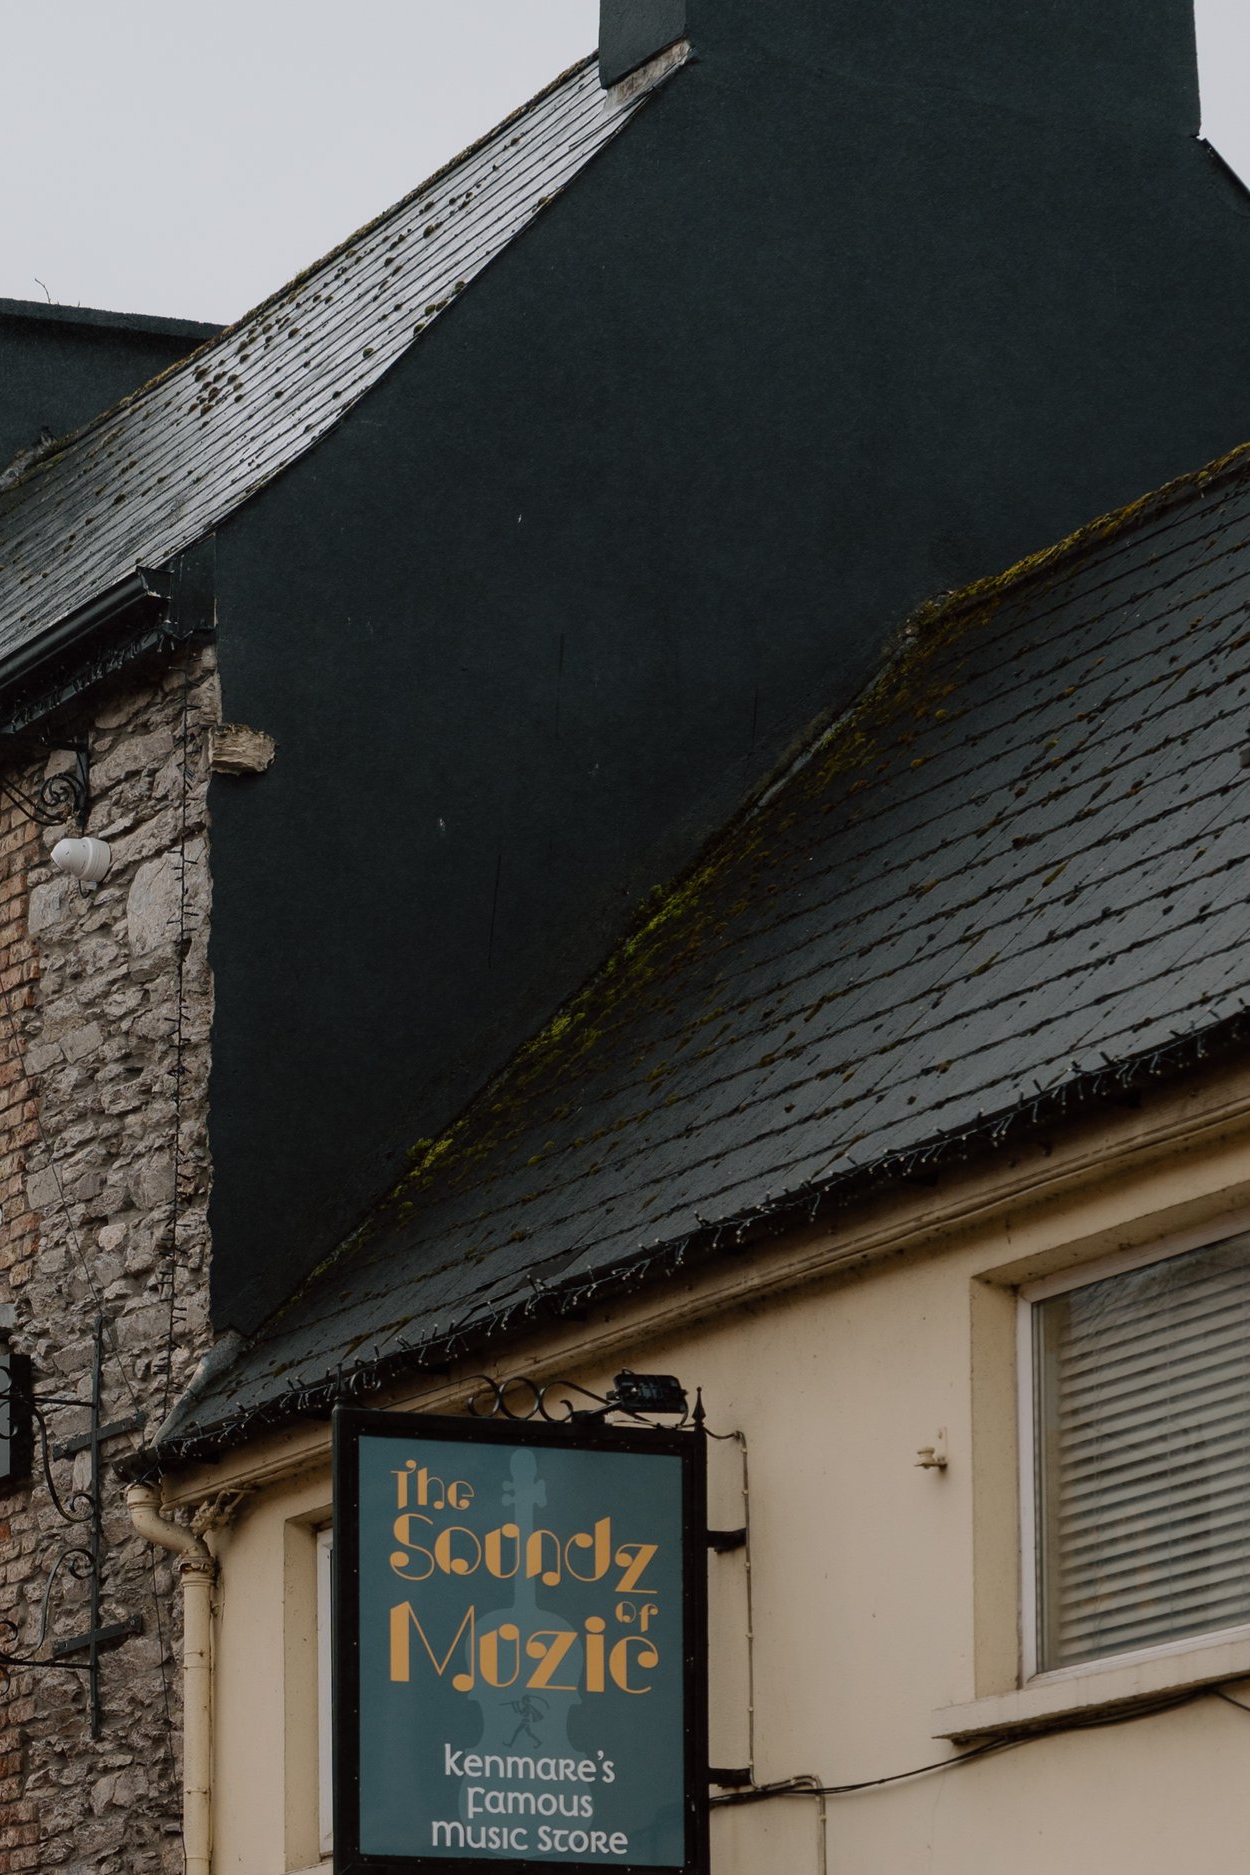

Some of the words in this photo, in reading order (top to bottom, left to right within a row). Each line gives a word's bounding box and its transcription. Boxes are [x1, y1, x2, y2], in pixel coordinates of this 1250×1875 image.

[390, 1459, 475, 1510] The
[389, 1513, 659, 1594] Soundz
[389, 1600, 659, 1695] Muzic
